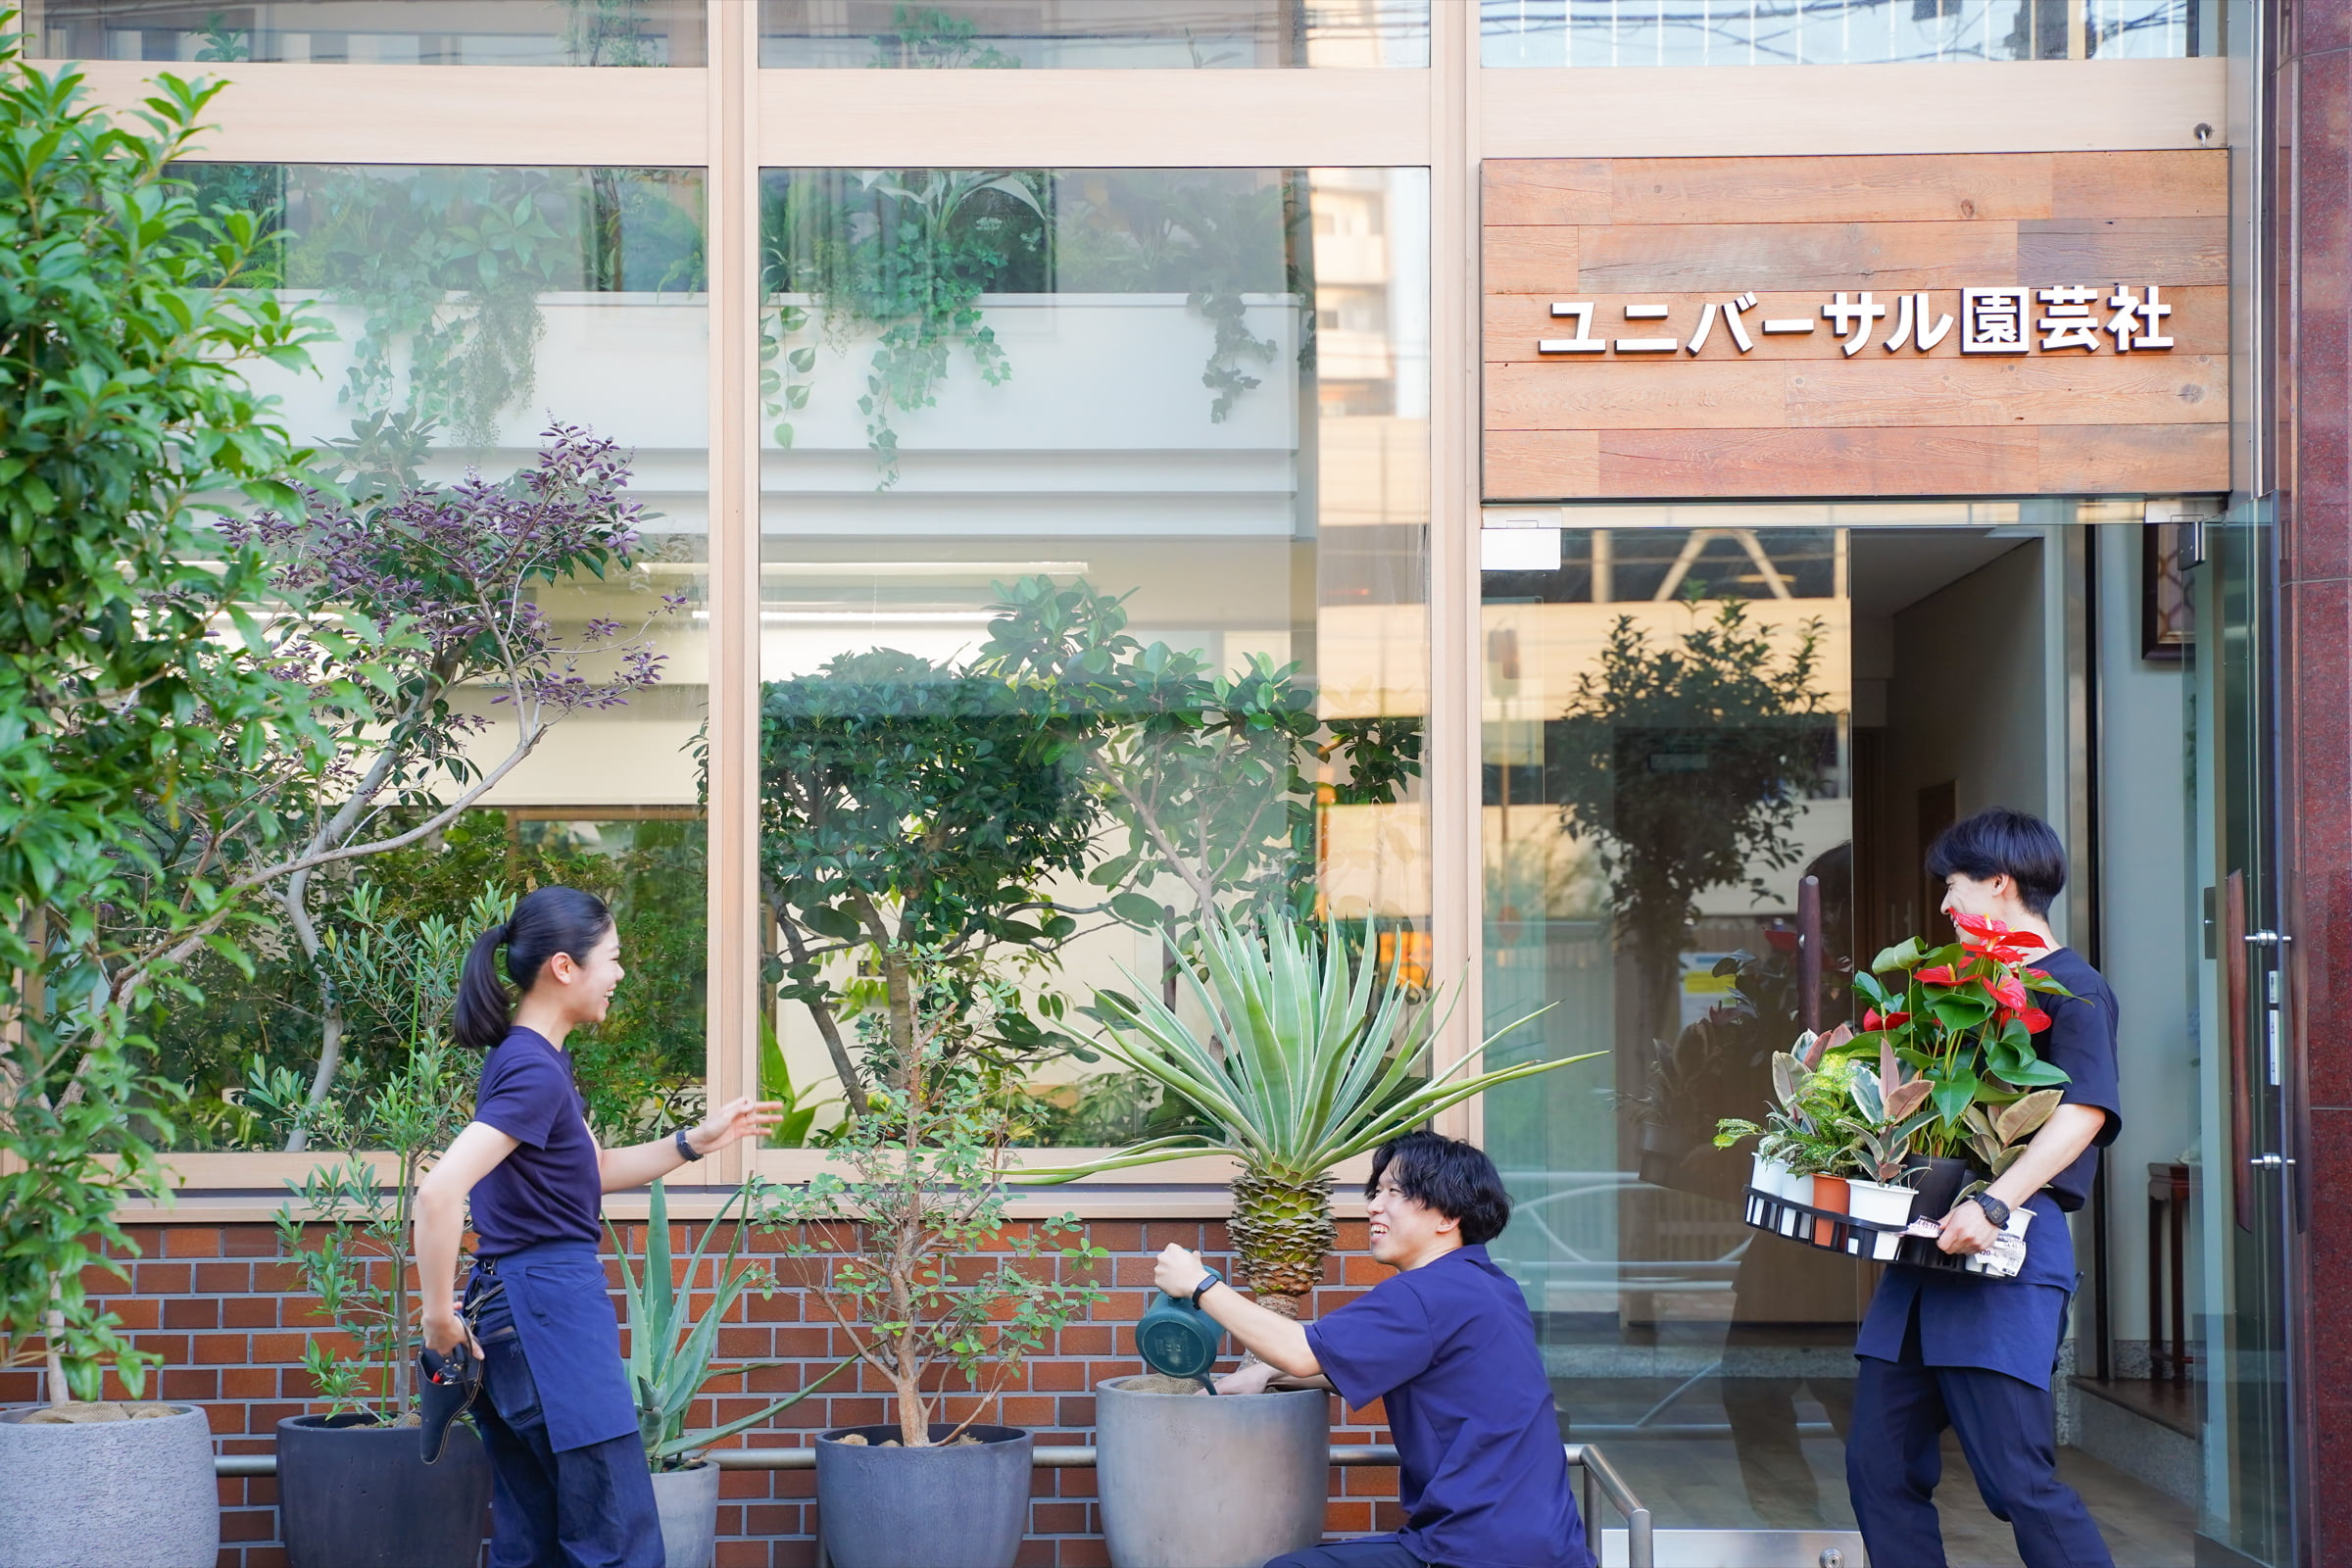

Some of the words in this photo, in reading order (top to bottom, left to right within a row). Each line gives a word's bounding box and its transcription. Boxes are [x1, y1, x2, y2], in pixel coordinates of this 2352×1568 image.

[1539, 285, 2174, 358] ユニバーサル園芸社
